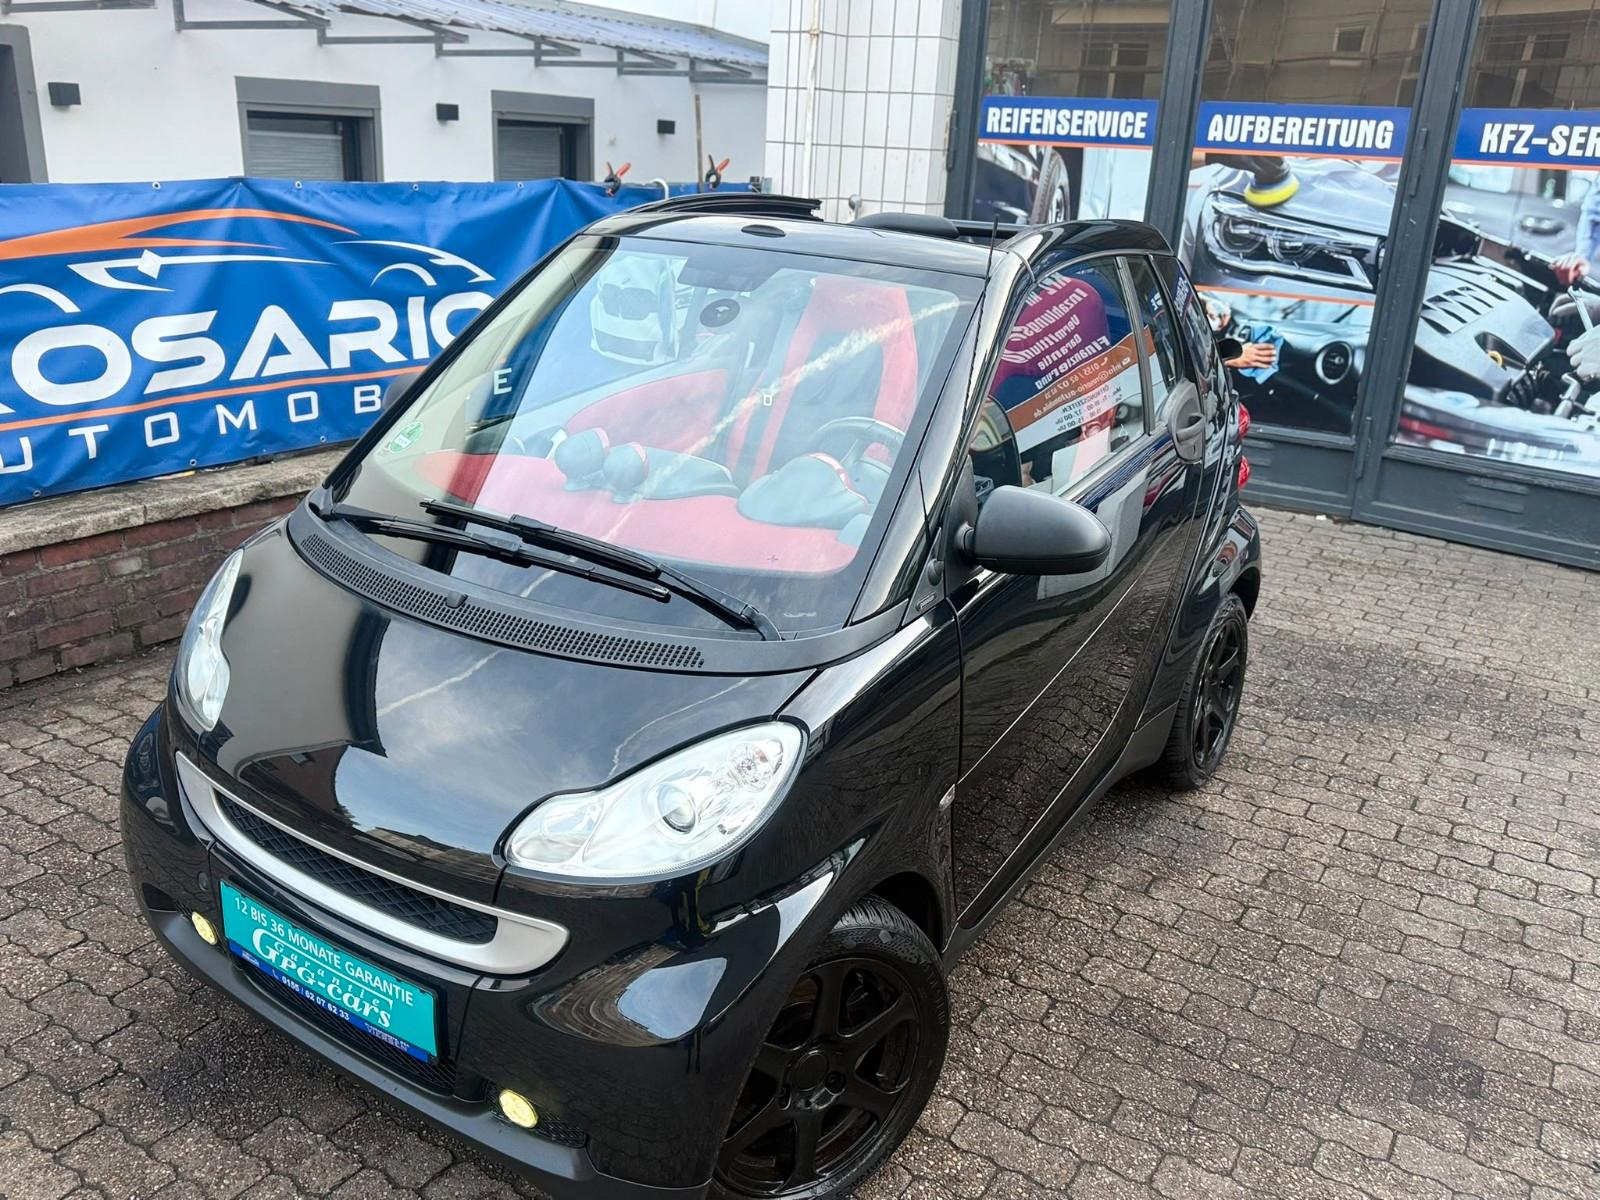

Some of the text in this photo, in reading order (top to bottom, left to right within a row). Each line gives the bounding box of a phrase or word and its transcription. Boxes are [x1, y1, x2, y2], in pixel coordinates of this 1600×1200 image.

[986, 106, 1149, 139] REIFENSERVICE
[1207, 114, 1395, 149] AUFBEREITUNG
[235, 896, 414, 1007] 12 BIS 36 MONATE GARANTIE
[282, 976, 300, 993] 0155
[305, 988, 315, 1001] 62
[316, 995, 327, 1006] 07
[328, 1002, 339, 1014] 62
[339, 1009, 350, 1021] 33
